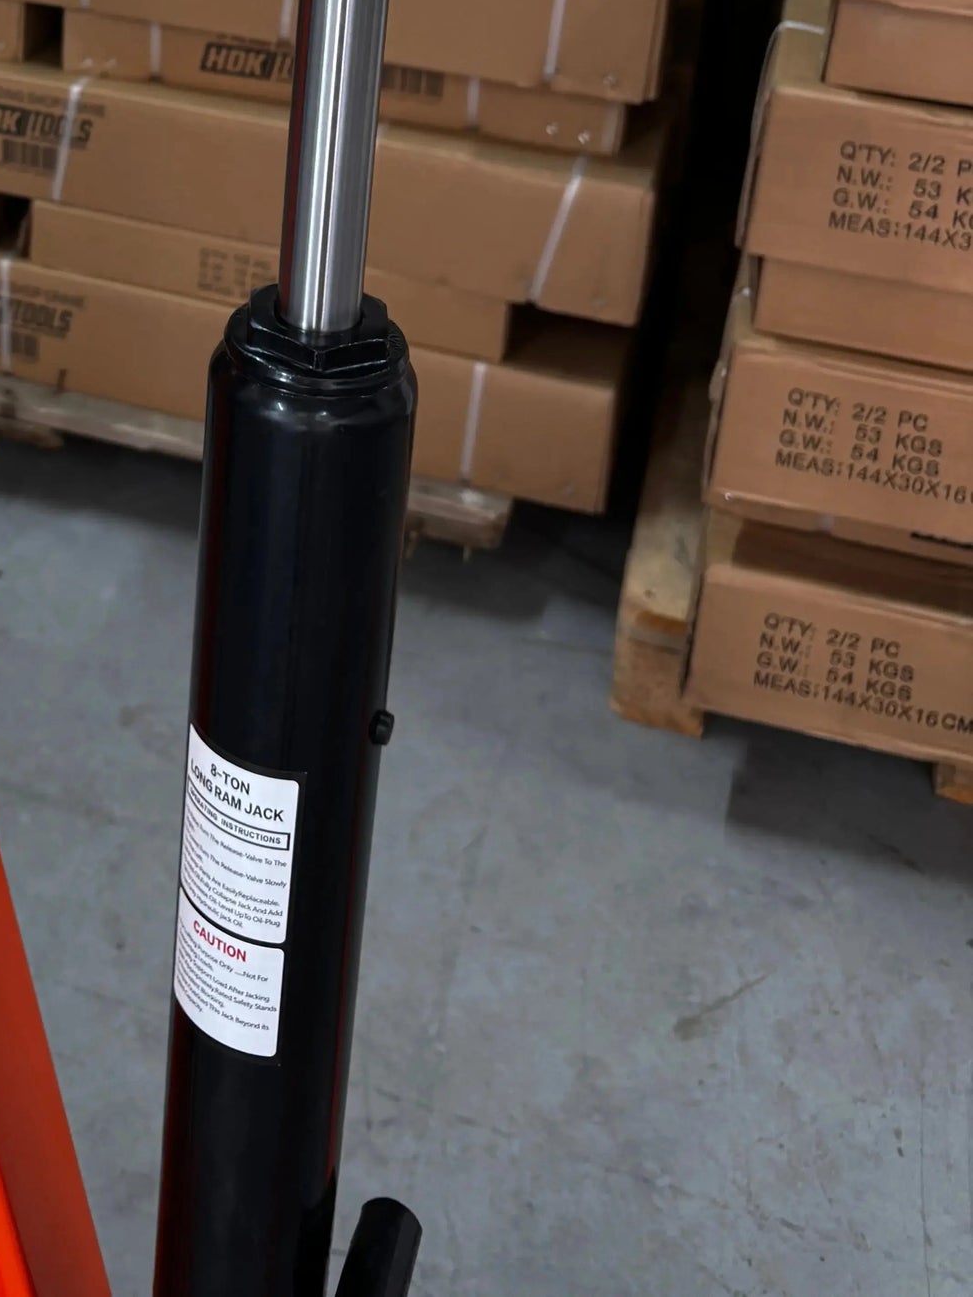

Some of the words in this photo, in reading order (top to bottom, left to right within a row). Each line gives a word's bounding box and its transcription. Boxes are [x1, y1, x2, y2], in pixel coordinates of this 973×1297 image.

[207, 45, 267, 76] HDK
[908, 153, 946, 175] 2/2
[913, 178, 942, 200] 53
[908, 200, 939, 220] 54
[852, 403, 887, 425] 2/2
[897, 410, 929, 432] PC
[895, 433, 943, 458] KGS
[892, 454, 940, 477] KGS
[827, 629, 861, 651] 2/2
[870, 637, 901, 658] PC
[868, 659, 915, 683] KGS
[866, 679, 912, 702] KGS
[191, 758, 212, 792] LONG
[214, 786, 242, 810] RAM
[245, 802, 284, 822] JACK
[211, 763, 250, 795] 8-TON
[221, 818, 281, 845] INSTRUCTIONS
[193, 920, 246, 962] CAUTION
